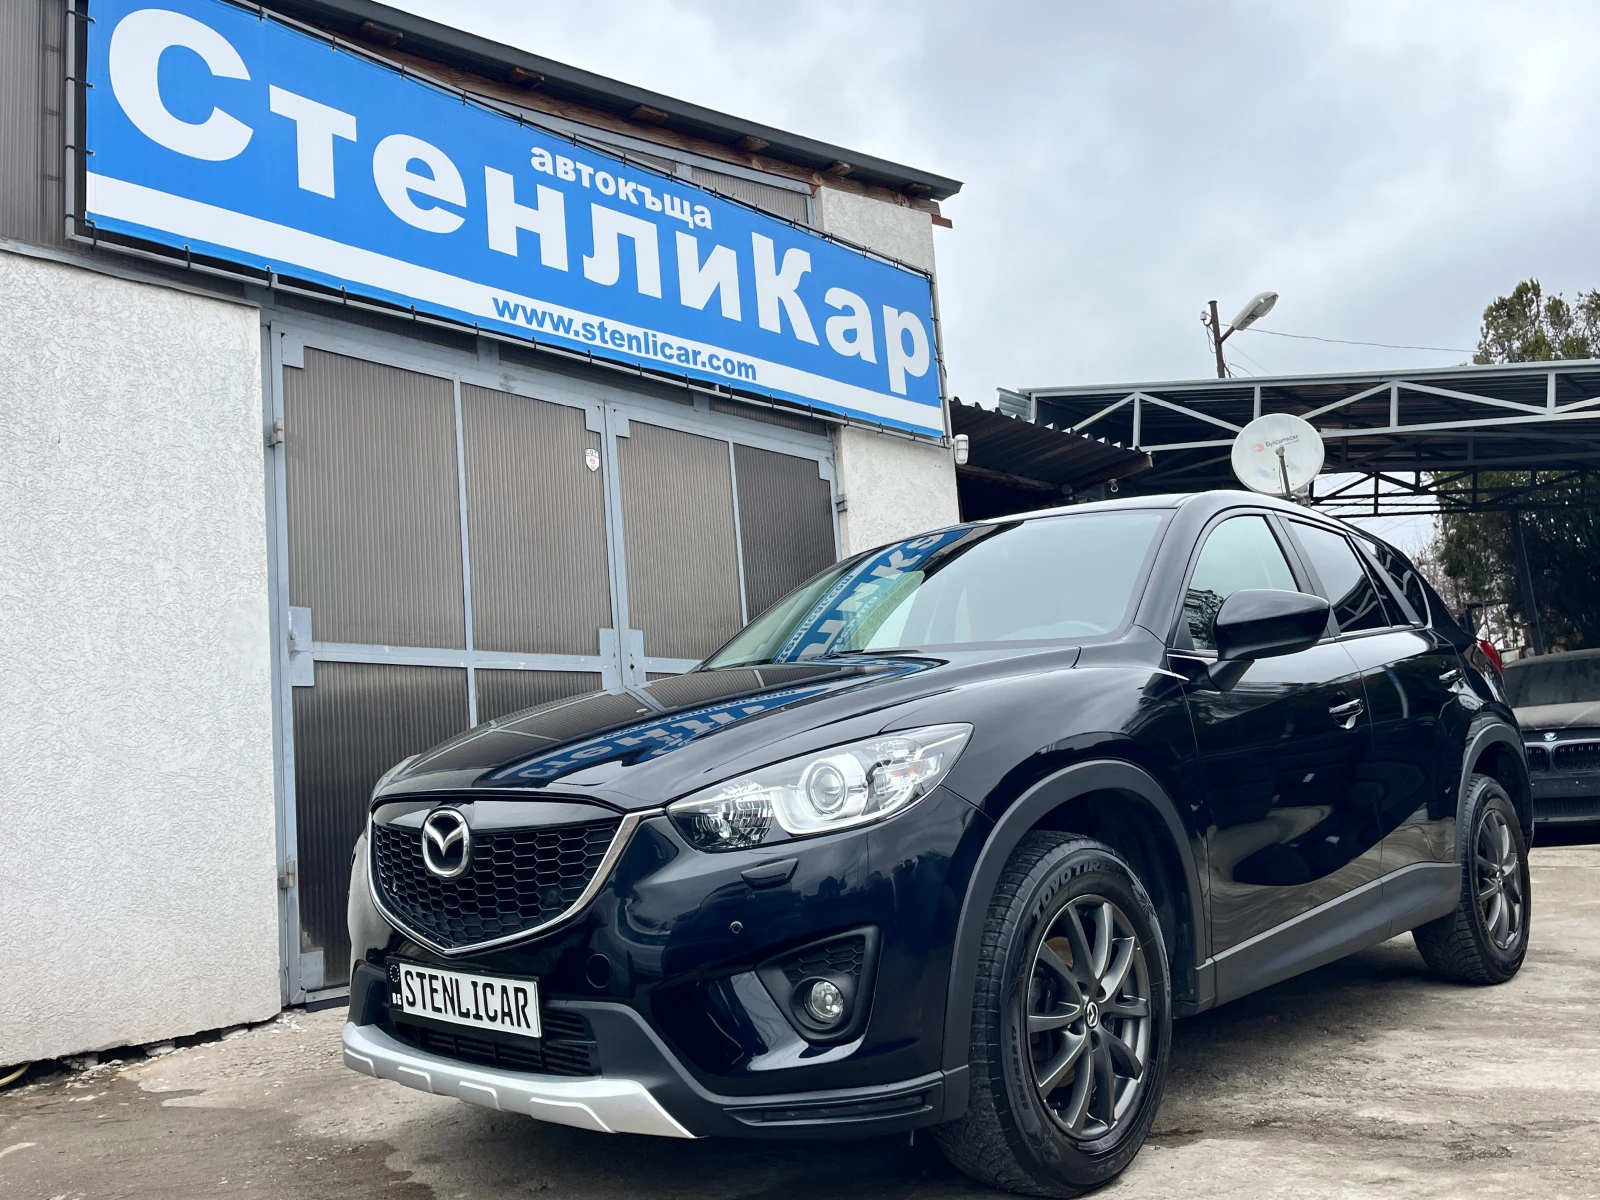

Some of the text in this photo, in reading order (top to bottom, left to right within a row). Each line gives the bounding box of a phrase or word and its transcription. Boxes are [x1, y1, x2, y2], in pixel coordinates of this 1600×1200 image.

[109, 8, 930, 394] СтенлиКар
[531, 147, 712, 230] автокъща
[492, 297, 757, 381] www.stenlicar.com
[1032, 867, 1072, 921] TOYO
[404, 969, 531, 1029] STENLICAR
